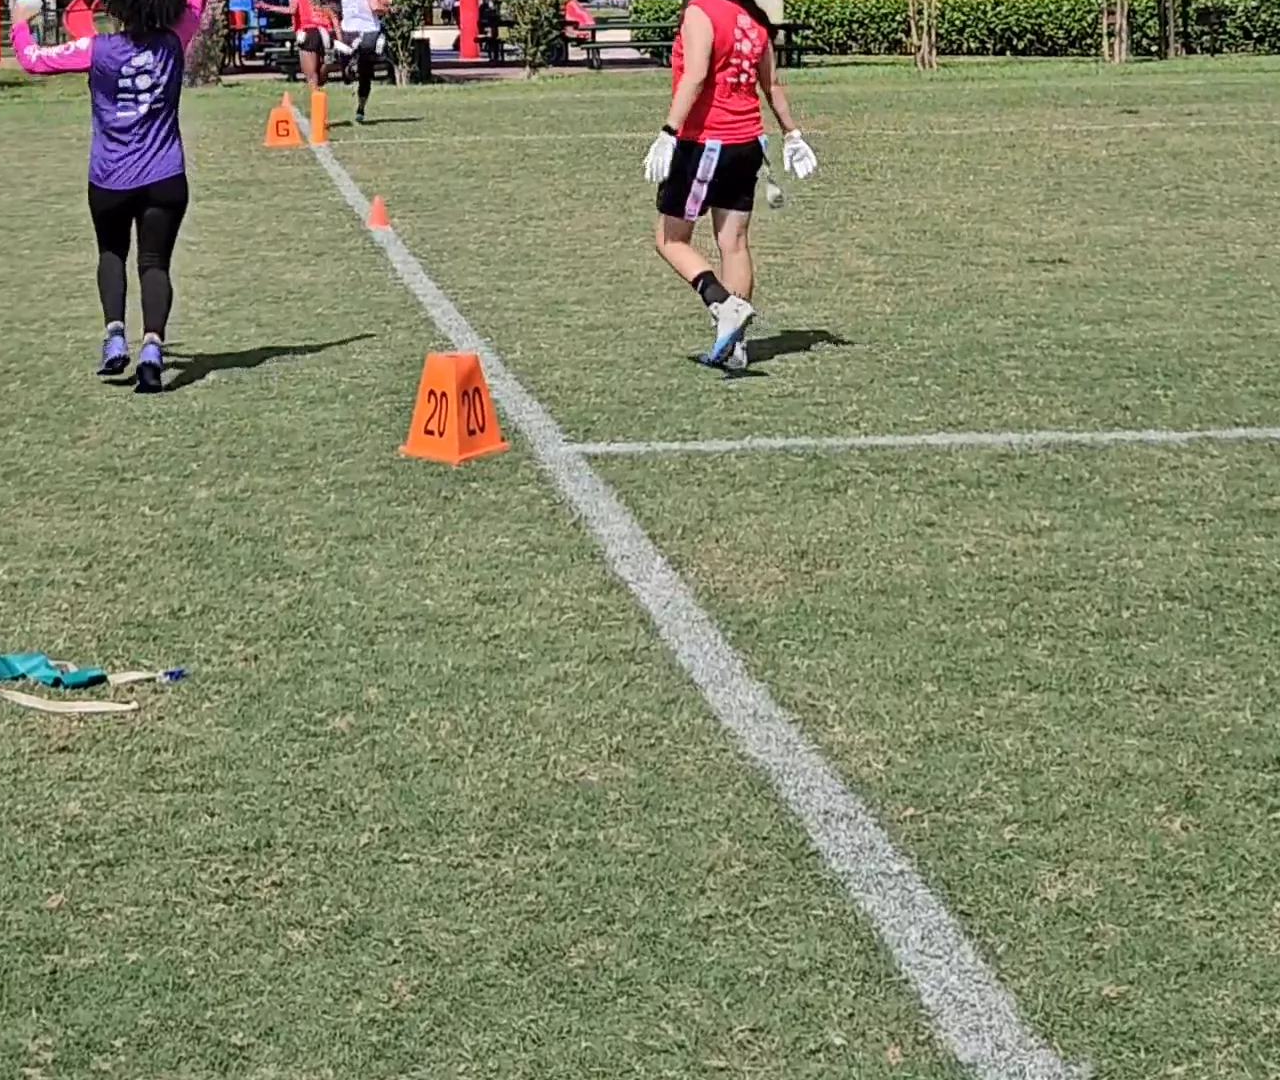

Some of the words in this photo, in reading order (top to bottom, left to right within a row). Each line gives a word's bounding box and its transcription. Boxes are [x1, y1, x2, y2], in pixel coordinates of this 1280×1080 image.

[276, 120, 290, 137] G
[424, 388, 448, 438] 20
[461, 386, 486, 437] 20
